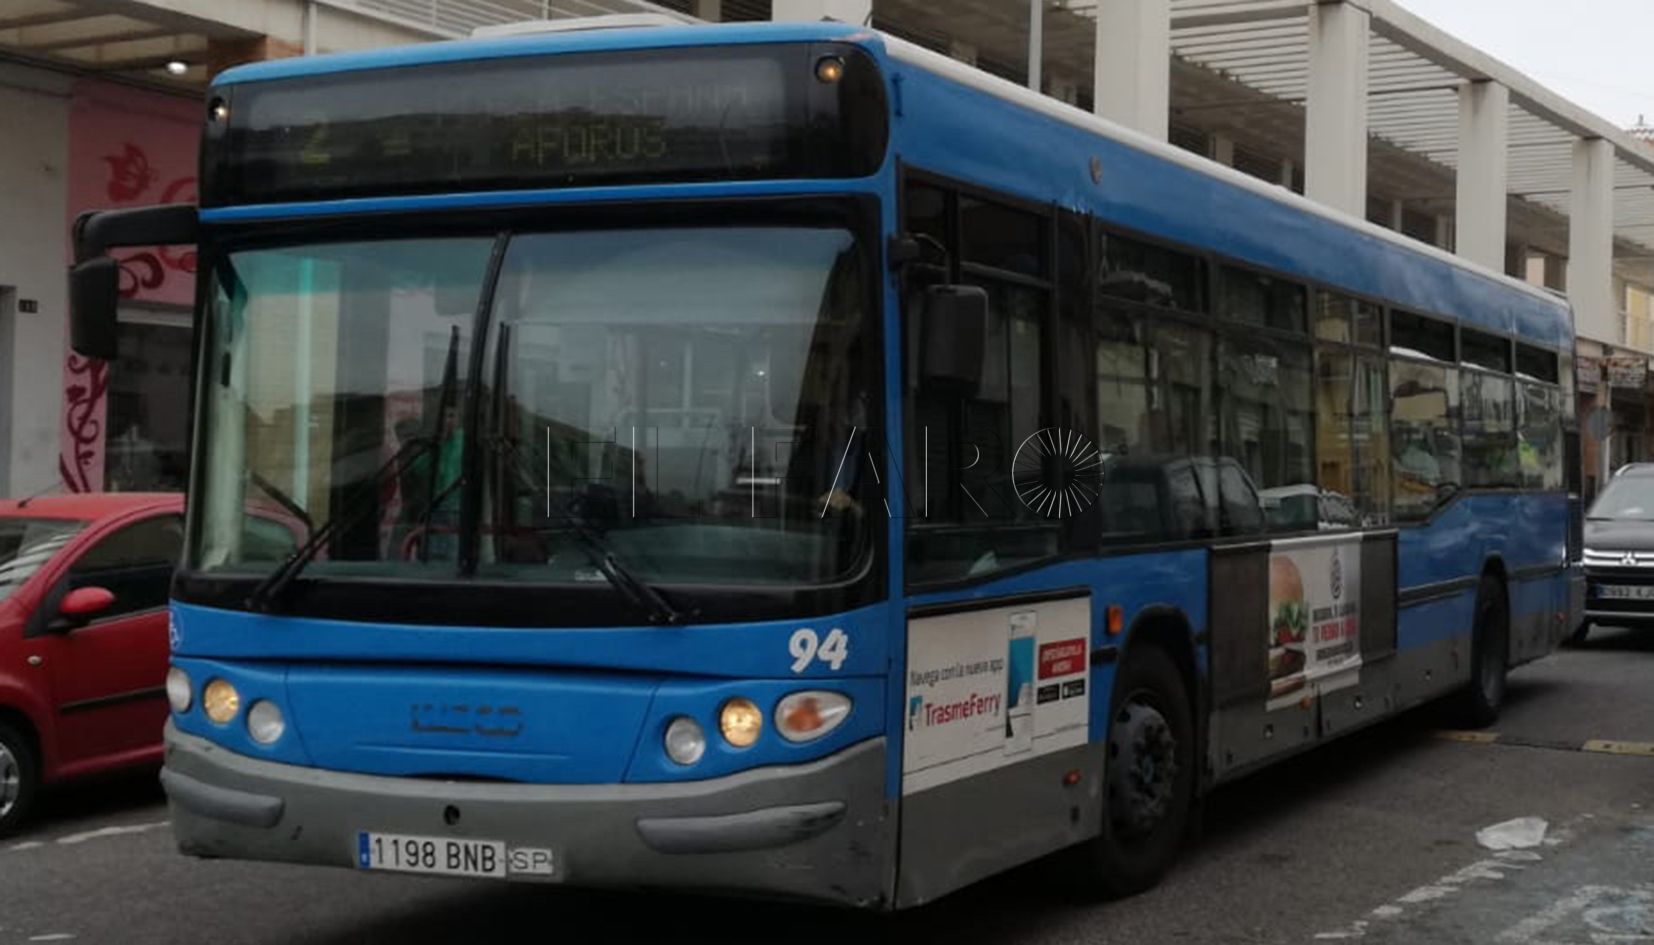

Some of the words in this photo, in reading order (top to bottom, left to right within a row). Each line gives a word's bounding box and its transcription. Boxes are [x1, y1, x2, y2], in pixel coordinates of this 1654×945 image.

[789, 628, 848, 672] 94
[925, 692, 1001, 727] TrasmeFerry
[375, 837, 436, 868] 1198
[446, 841, 496, 873] BNB
[512, 851, 548, 870] SP
